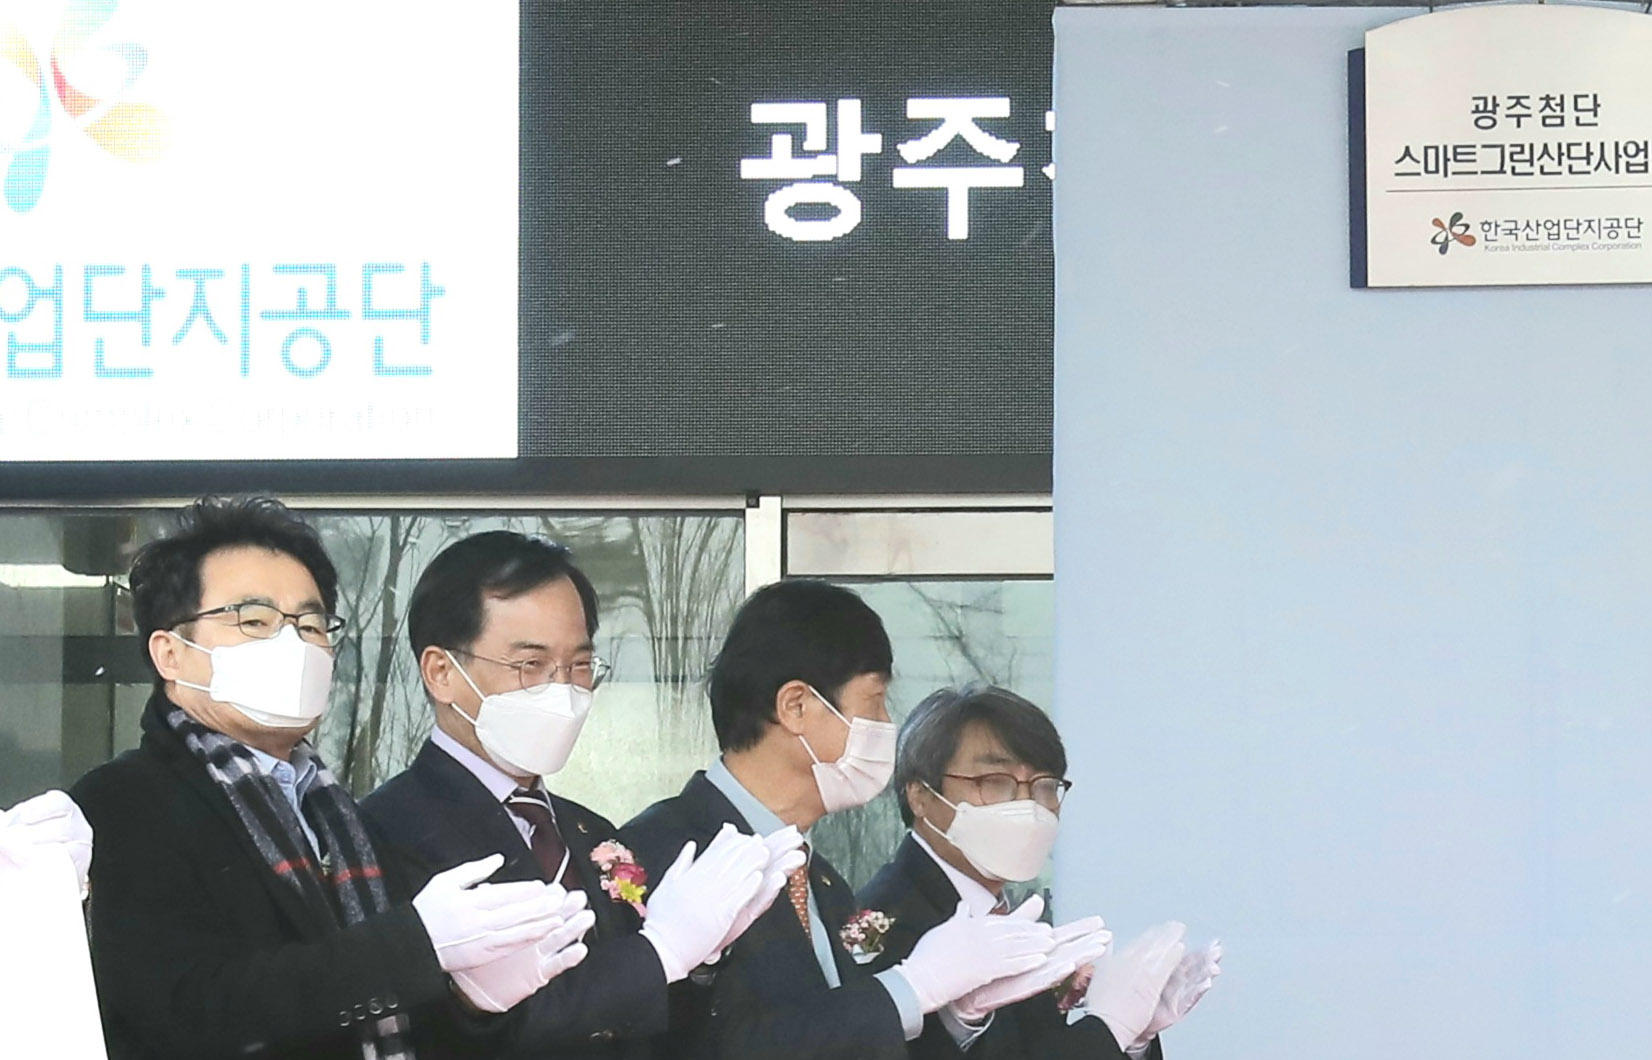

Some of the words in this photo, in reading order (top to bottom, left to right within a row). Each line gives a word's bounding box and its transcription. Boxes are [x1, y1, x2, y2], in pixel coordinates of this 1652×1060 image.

[1471, 94, 1602, 130] 광주첨단
[740, 97, 1054, 241] 광주
[1479, 217, 1644, 242] 한국산업단지공단
[1552, 242, 1590, 252] Complex
[1591, 241, 1642, 252] Corporation
[0, 261, 446, 379] 업단지공단
